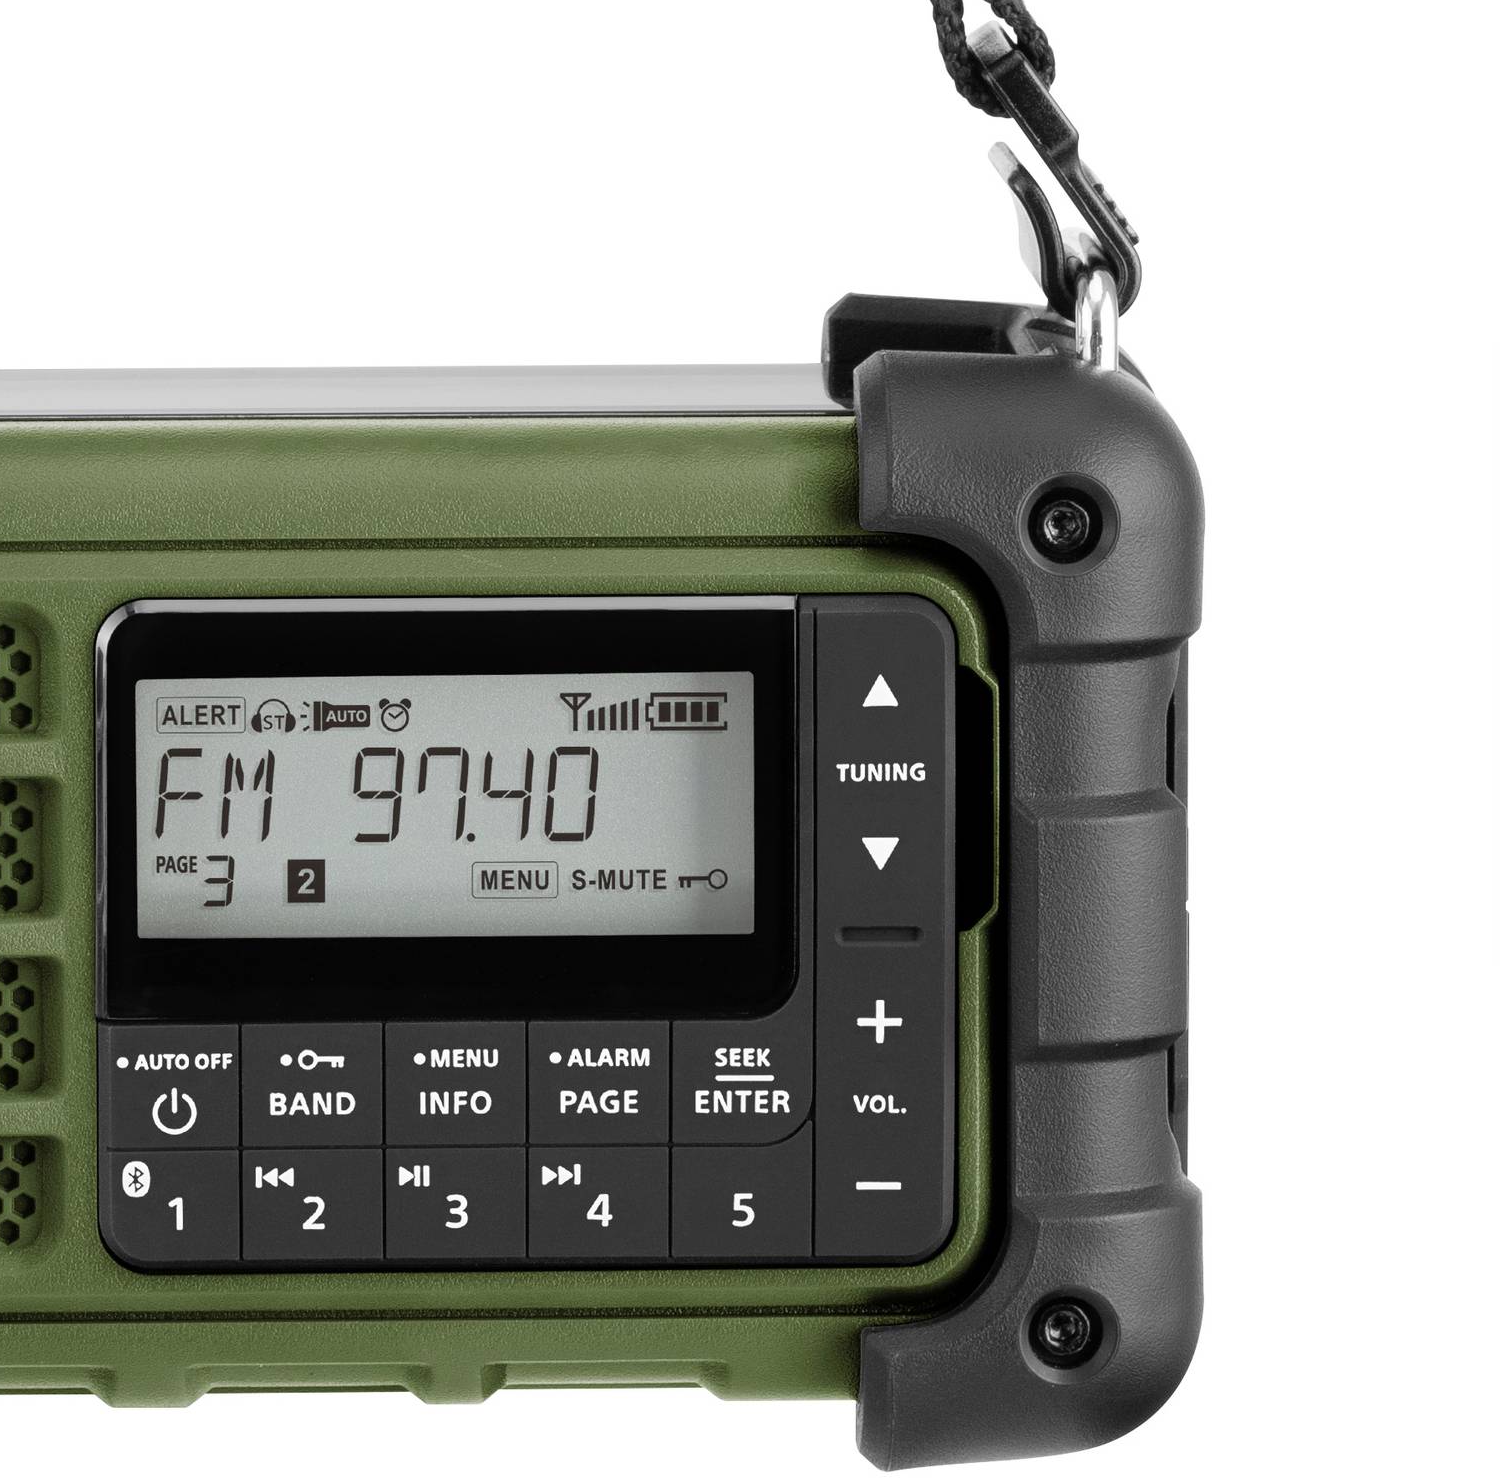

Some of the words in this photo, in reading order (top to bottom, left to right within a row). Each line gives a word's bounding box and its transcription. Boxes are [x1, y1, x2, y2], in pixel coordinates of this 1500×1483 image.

[161, 704, 241, 726] ALERT
[263, 714, 285, 730] ST
[325, 709, 367, 723] AUTO
[835, 762, 926, 783] TUNING
[155, 747, 276, 842] FM
[353, 747, 599, 843] 97.40
[155, 855, 198, 874] PAGE
[203, 855, 235, 907] 3
[297, 868, 315, 894] 2
[481, 869, 549, 891] MENU
[571, 869, 667, 891] S-MUTE
[134, 1053, 190, 1070] AUTO
[194, 1052, 233, 1070] OFF
[430, 1048, 499, 1068] MENU
[567, 1047, 651, 1068] ALARM
[714, 1047, 771, 1068] SEEK
[269, 1091, 356, 1116] BAND
[419, 1090, 492, 1115] INFO
[559, 1089, 639, 1114] PAGE
[695, 1089, 791, 1114] ENTER
[852, 1094, 907, 1114] VOL.
[168, 1197, 184, 1231] 1
[302, 1196, 326, 1230] 2
[445, 1193, 469, 1229] 3
[586, 1193, 613, 1228] 4
[731, 1192, 755, 1228] 5
